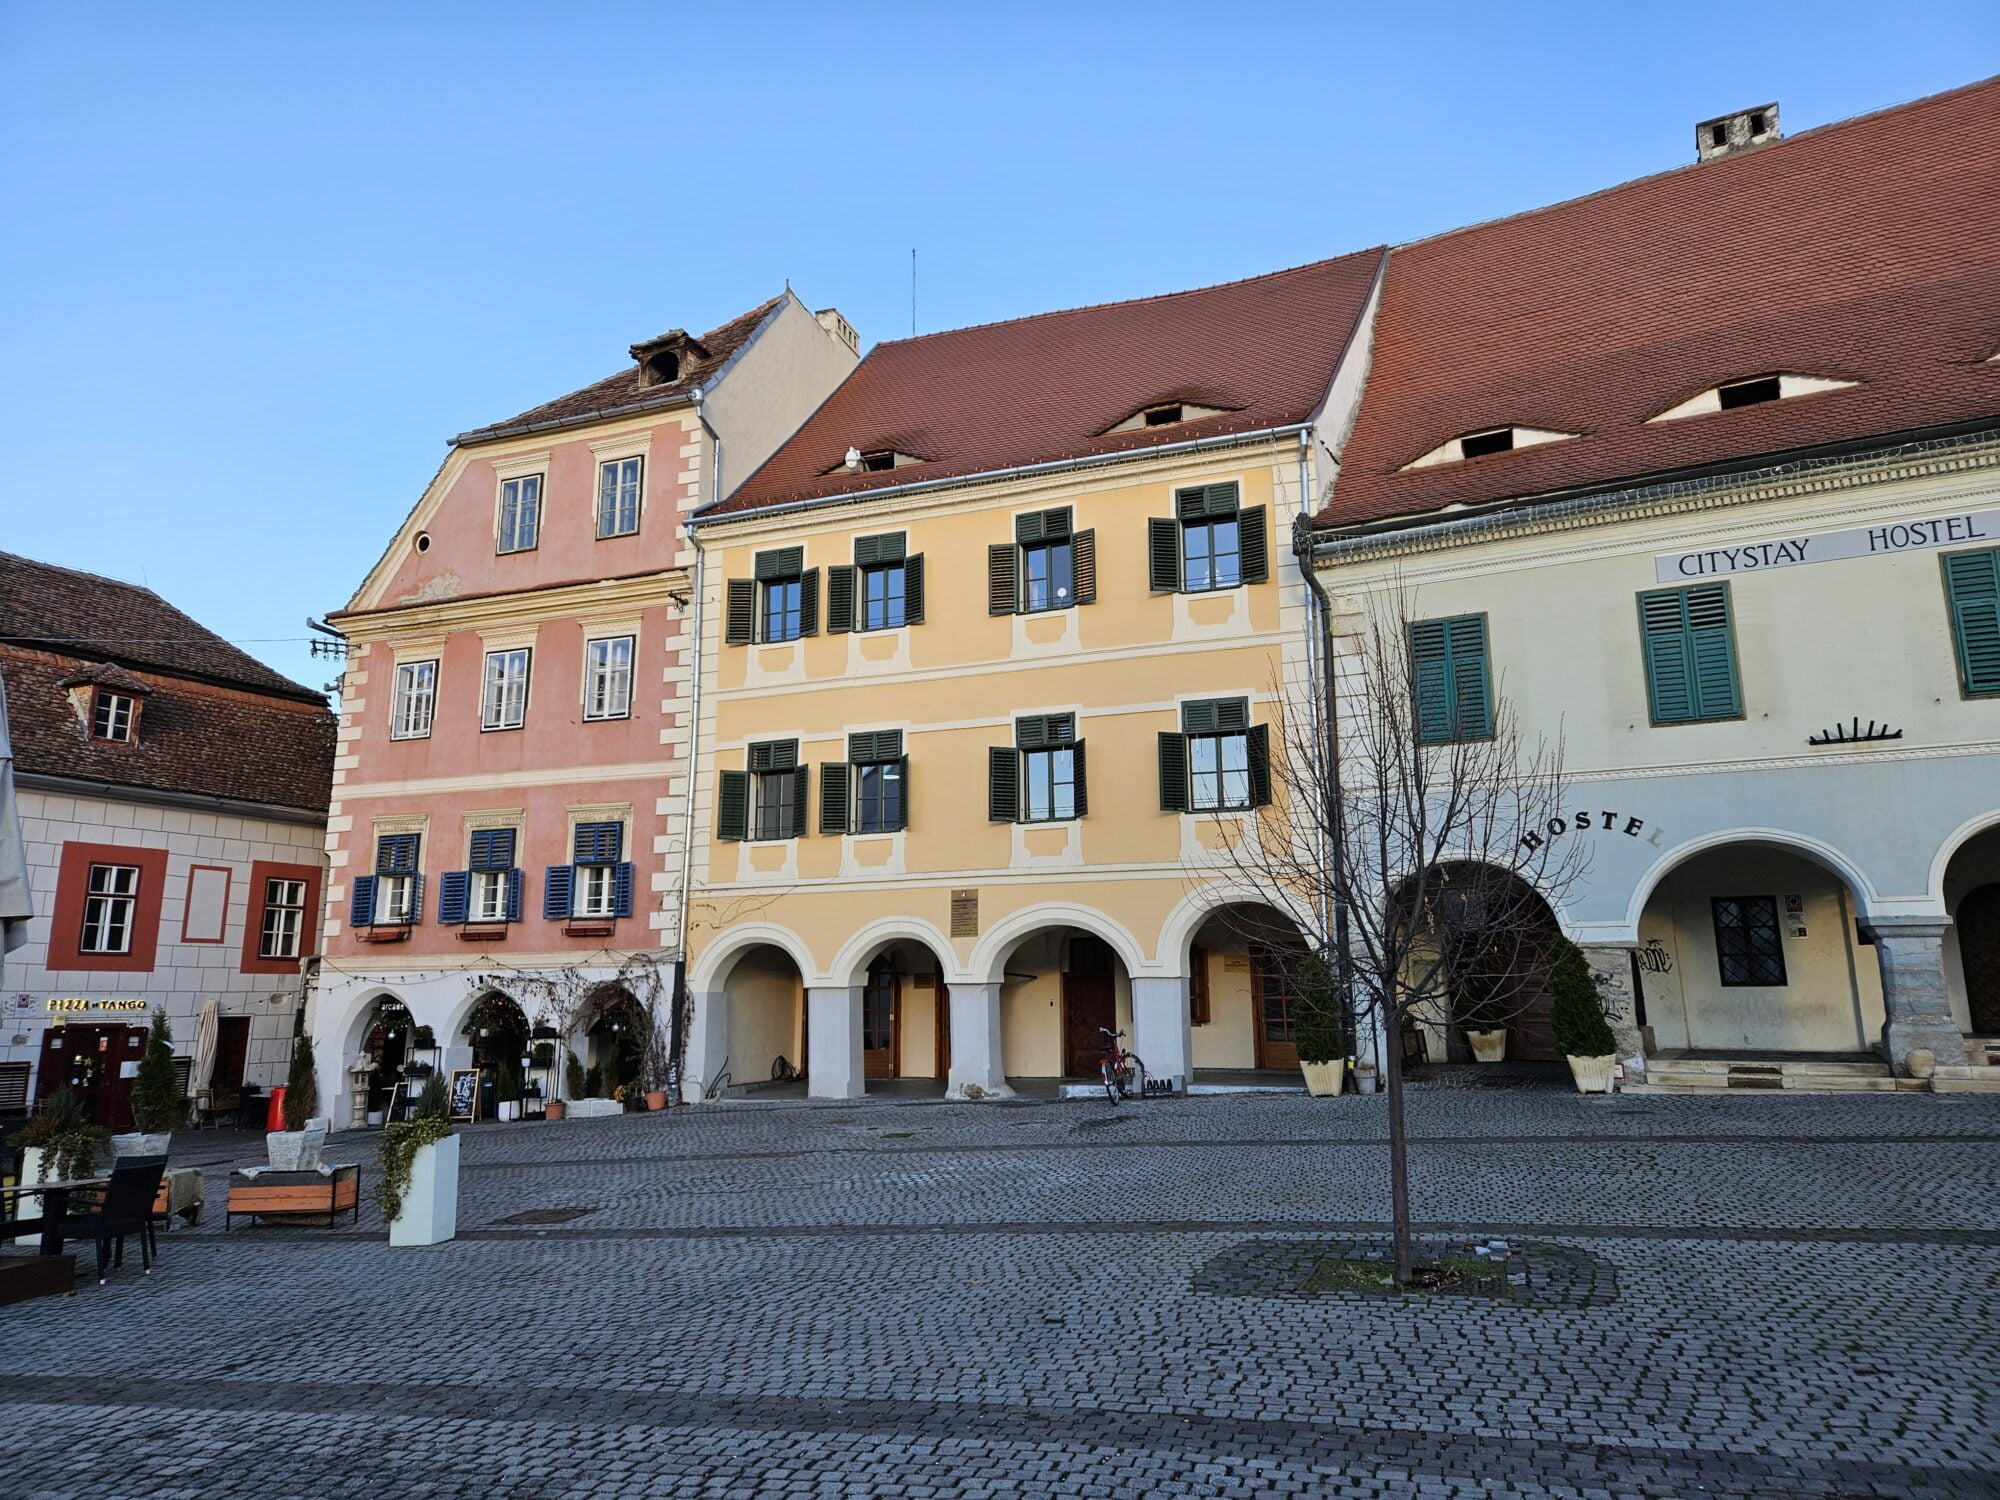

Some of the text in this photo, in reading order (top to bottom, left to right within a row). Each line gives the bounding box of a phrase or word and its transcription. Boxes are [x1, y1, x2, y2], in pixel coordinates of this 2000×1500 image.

[1678, 515, 1986, 576] CITYSTAY HOSTEL
[1519, 810, 1665, 851] HOSTEL
[47, 999, 90, 1012] PIZZA
[100, 1000, 147, 1011] TANGO
[381, 1002, 405, 1011] arcade
